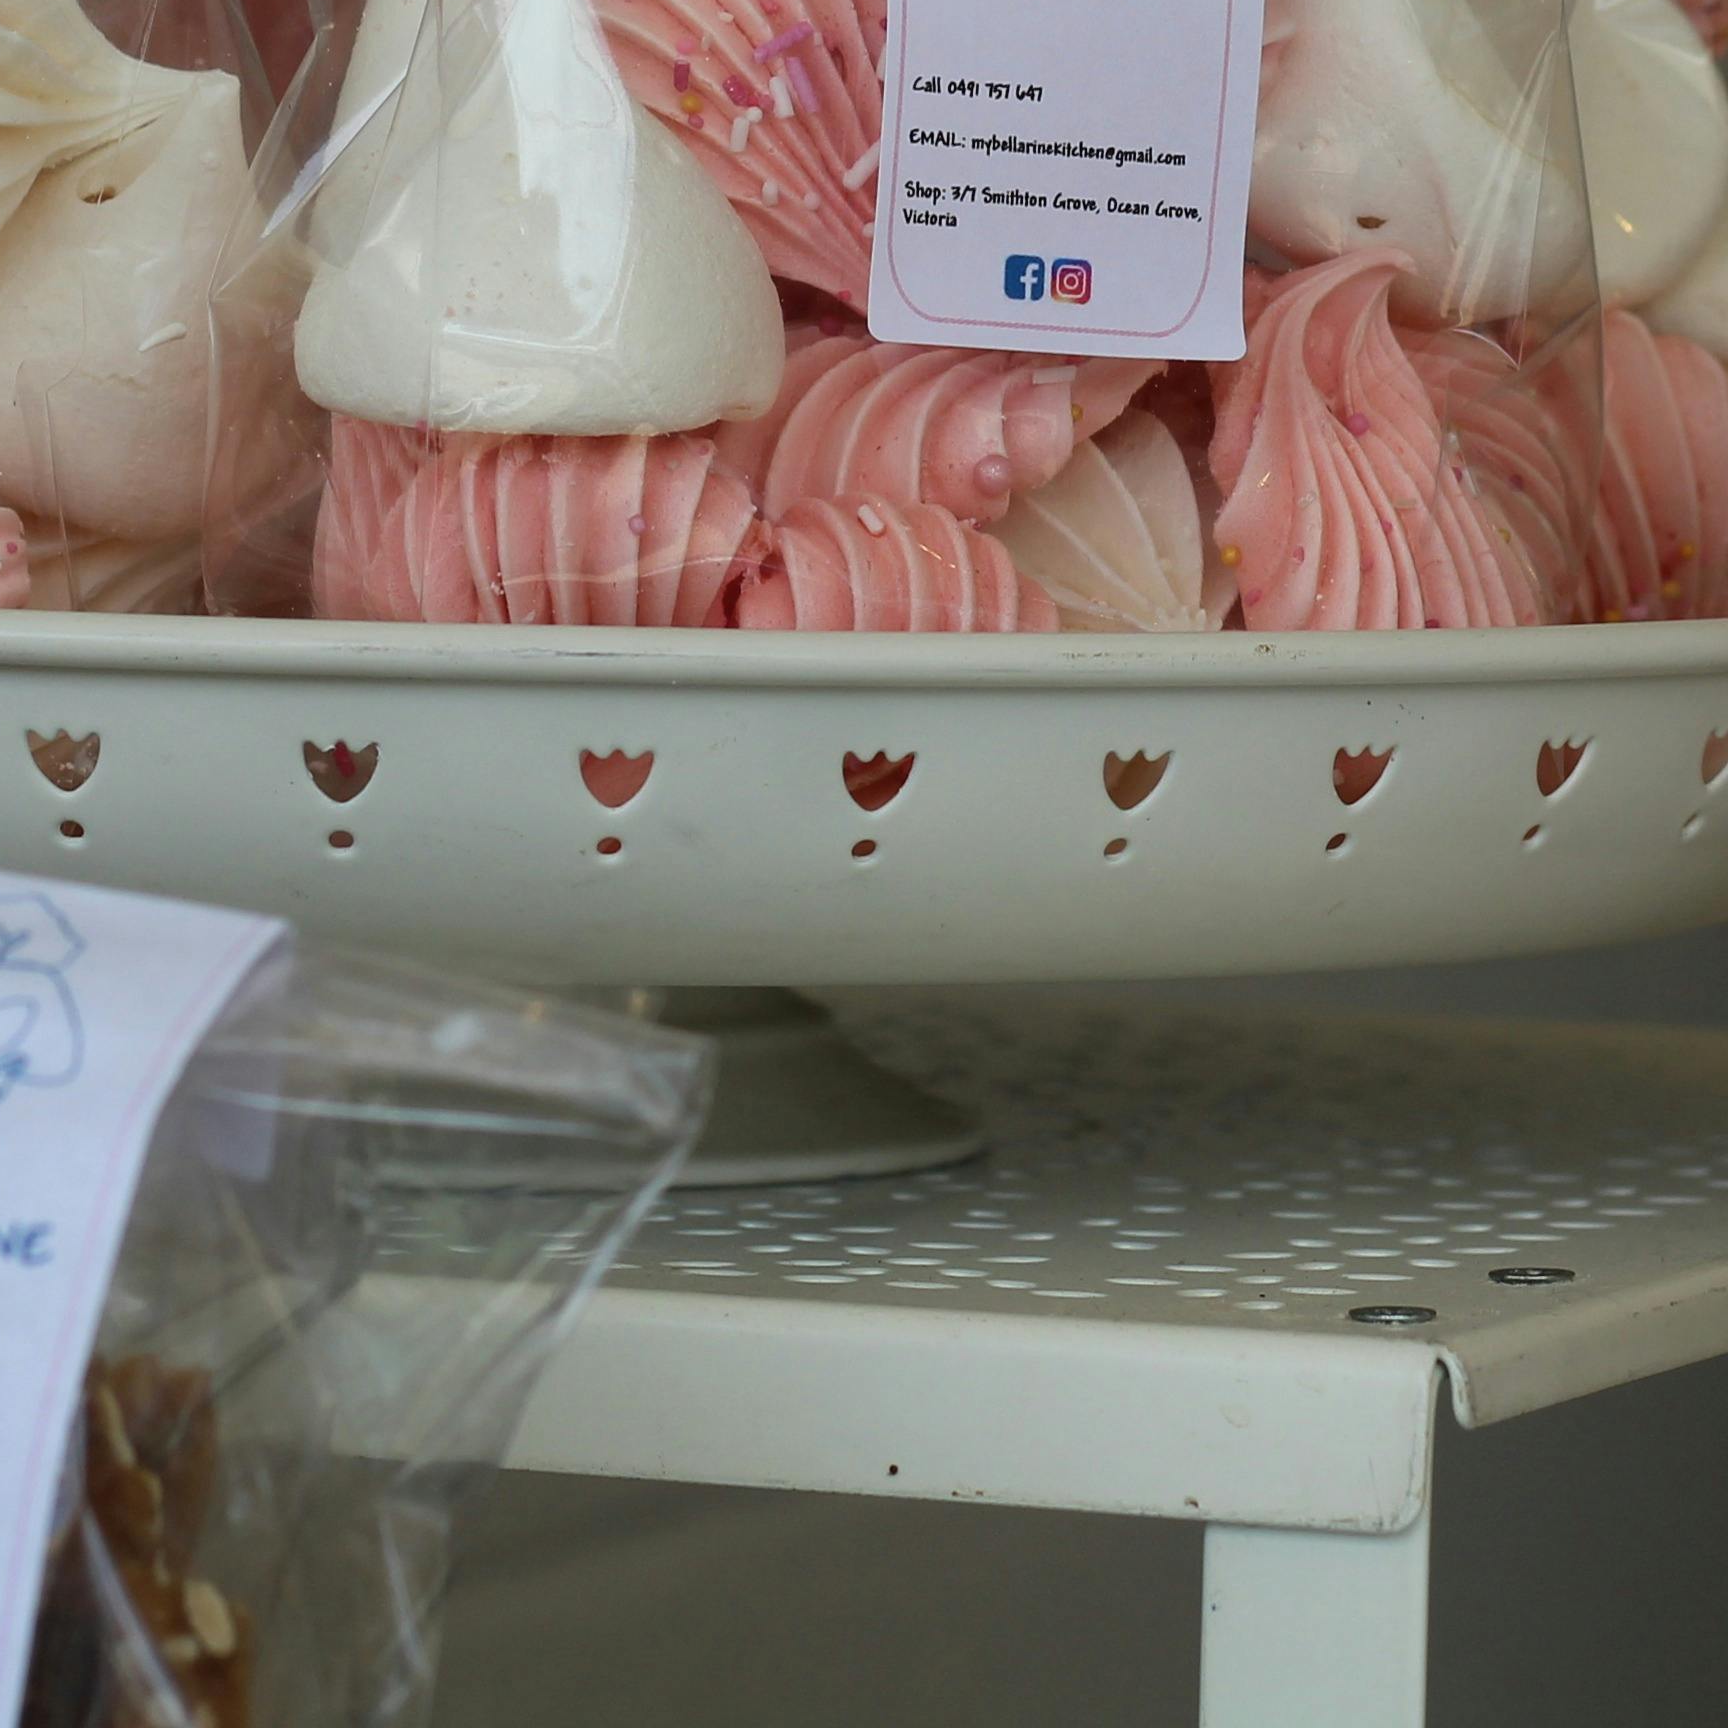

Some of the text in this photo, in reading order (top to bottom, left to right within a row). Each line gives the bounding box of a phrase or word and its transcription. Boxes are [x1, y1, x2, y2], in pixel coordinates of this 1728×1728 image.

[913, 76, 1043, 102] Call 0491 757 647
[909, 128, 1186, 167] EMAIL: mybellarinekitchen@gmail.com
[904, 180, 946, 206] Shop:
[981, 186, 1047, 208] Smithton
[1053, 192, 1100, 214] Grove,
[1107, 197, 1149, 216] Ocean
[1155, 200, 1203, 223] Grove,
[902, 208, 958, 228] Victoria
